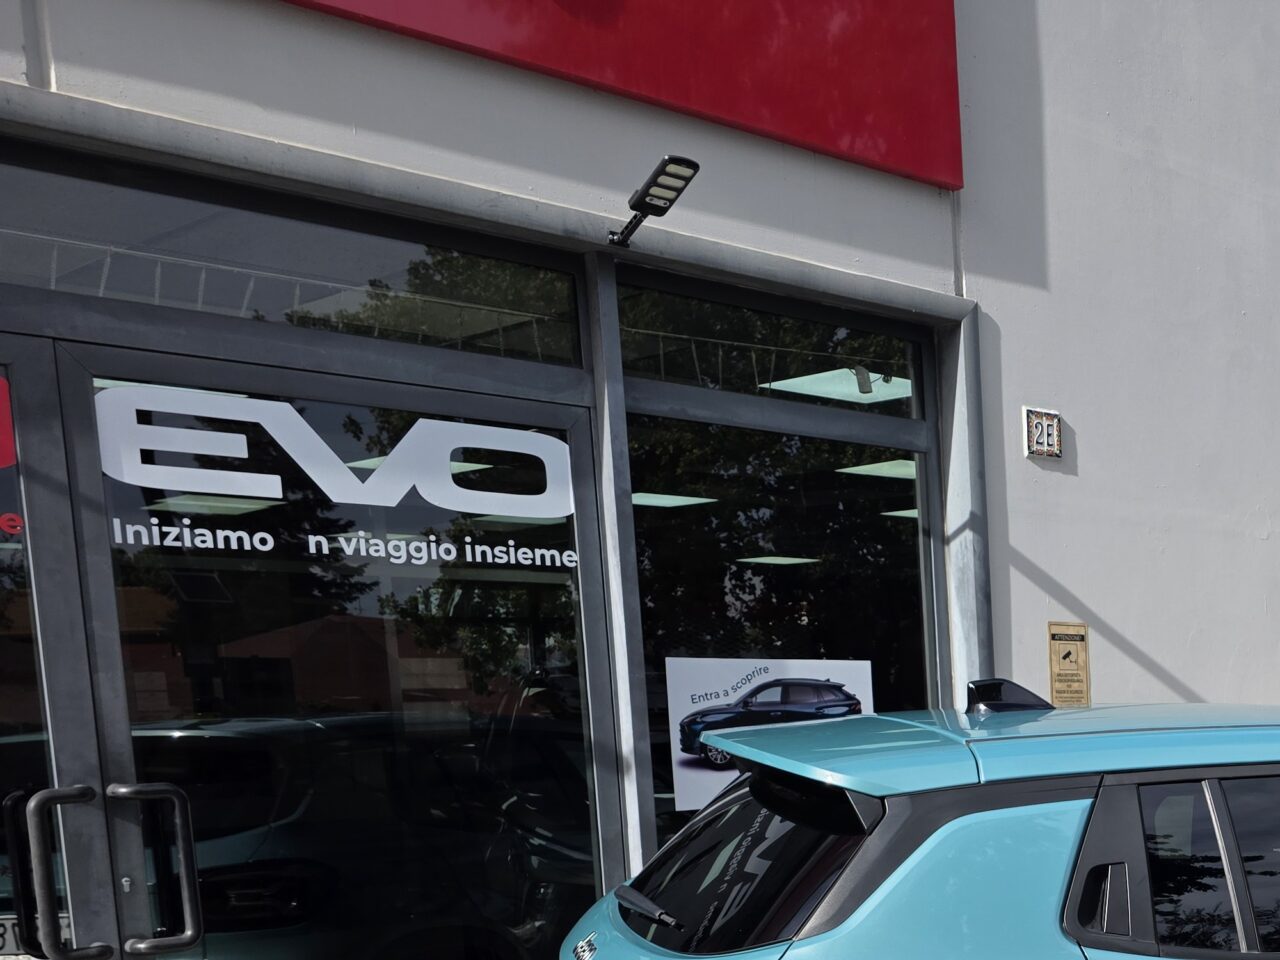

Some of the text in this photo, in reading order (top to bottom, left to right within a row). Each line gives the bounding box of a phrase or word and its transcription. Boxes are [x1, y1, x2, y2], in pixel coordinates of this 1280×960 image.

[94, 386, 575, 518] EVO
[1035, 421, 1054, 447] 2E
[112, 517, 275, 551] Iniziamo
[337, 530, 458, 566] viaggio
[464, 536, 578, 567] insieme
[690, 665, 769, 704] Entra a scoprire
